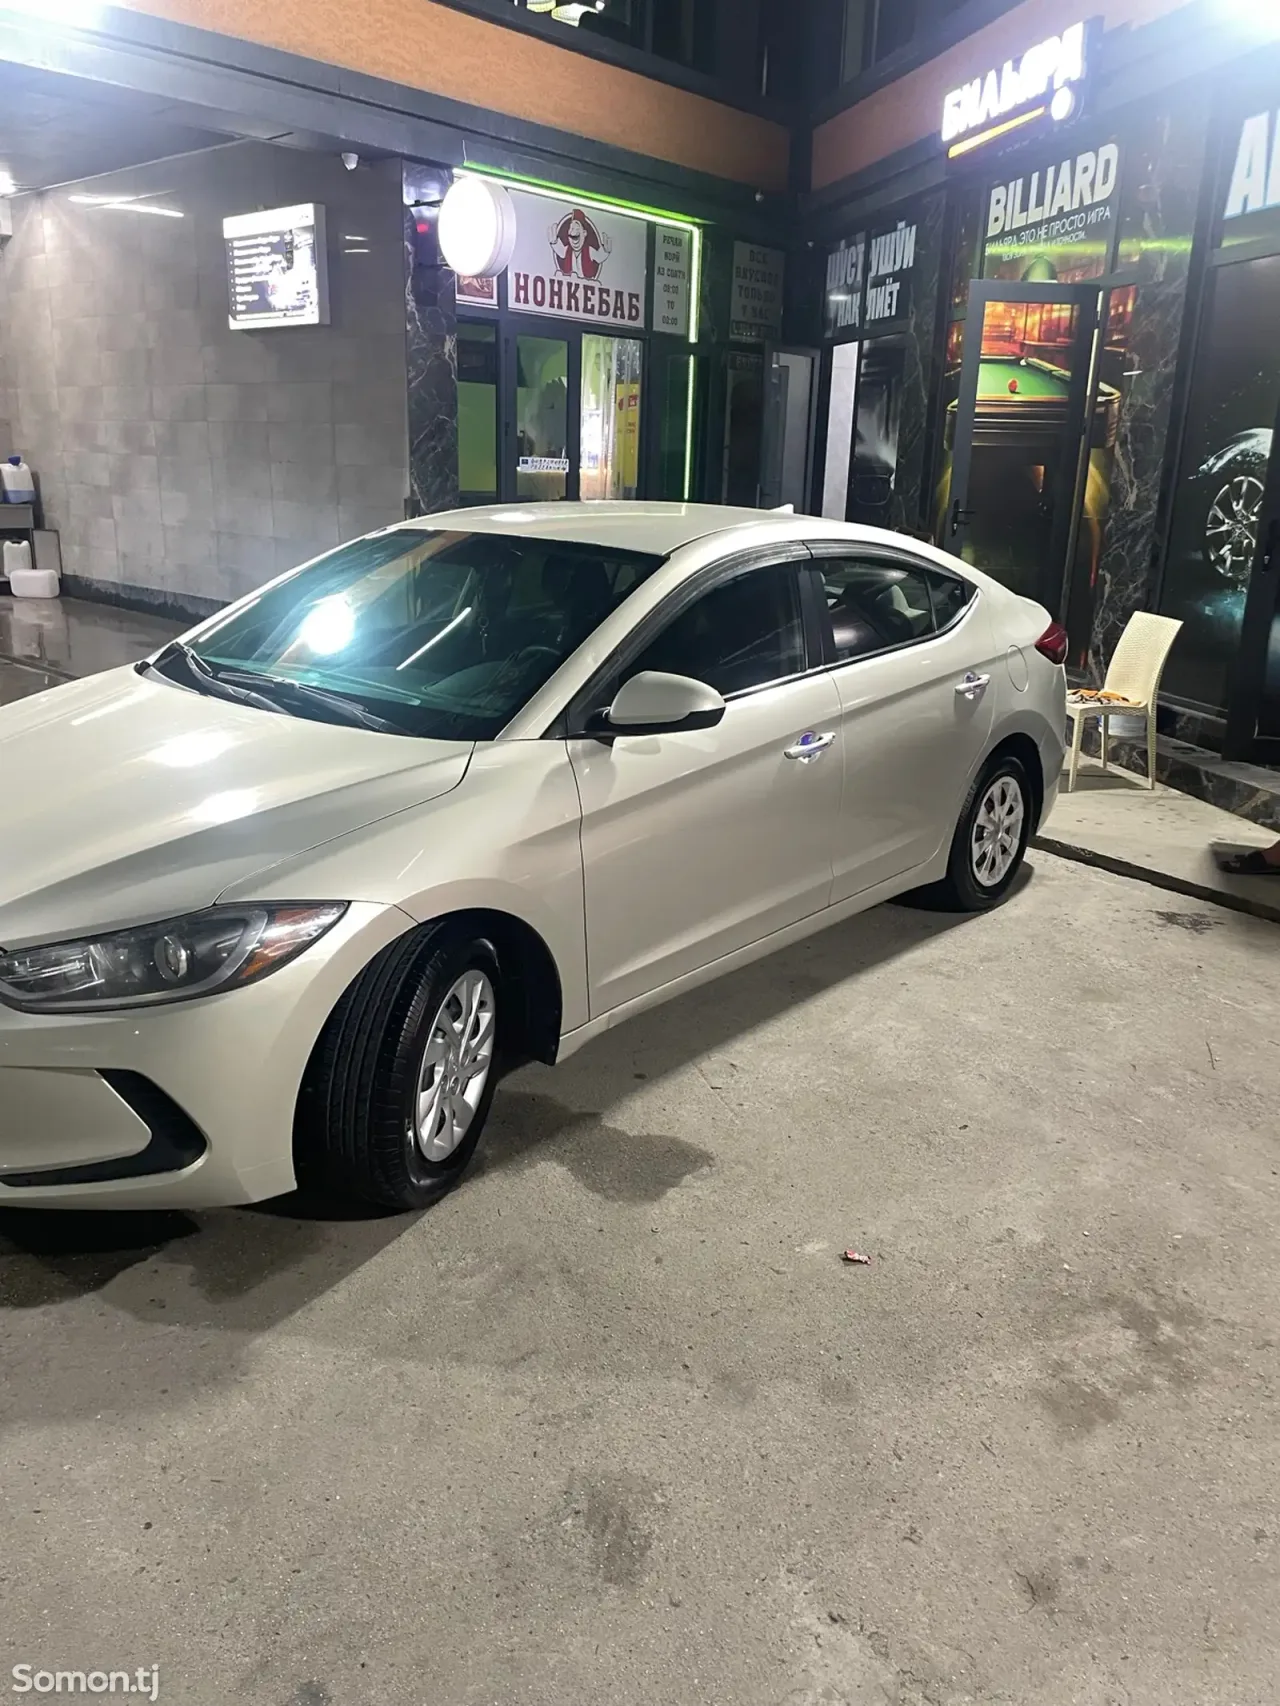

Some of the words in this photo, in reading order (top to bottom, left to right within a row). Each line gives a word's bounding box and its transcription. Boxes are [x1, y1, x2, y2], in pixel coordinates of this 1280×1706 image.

[986, 143, 1118, 237] BILLIARD
[1020, 228, 1036, 245] ЭТО
[1037, 221, 1049, 239] НЕ
[1049, 213, 1085, 236] ПРОСТО
[1087, 206, 1111, 224] ИГРА
[514, 272, 641, 322] НОНКЕБАБ
